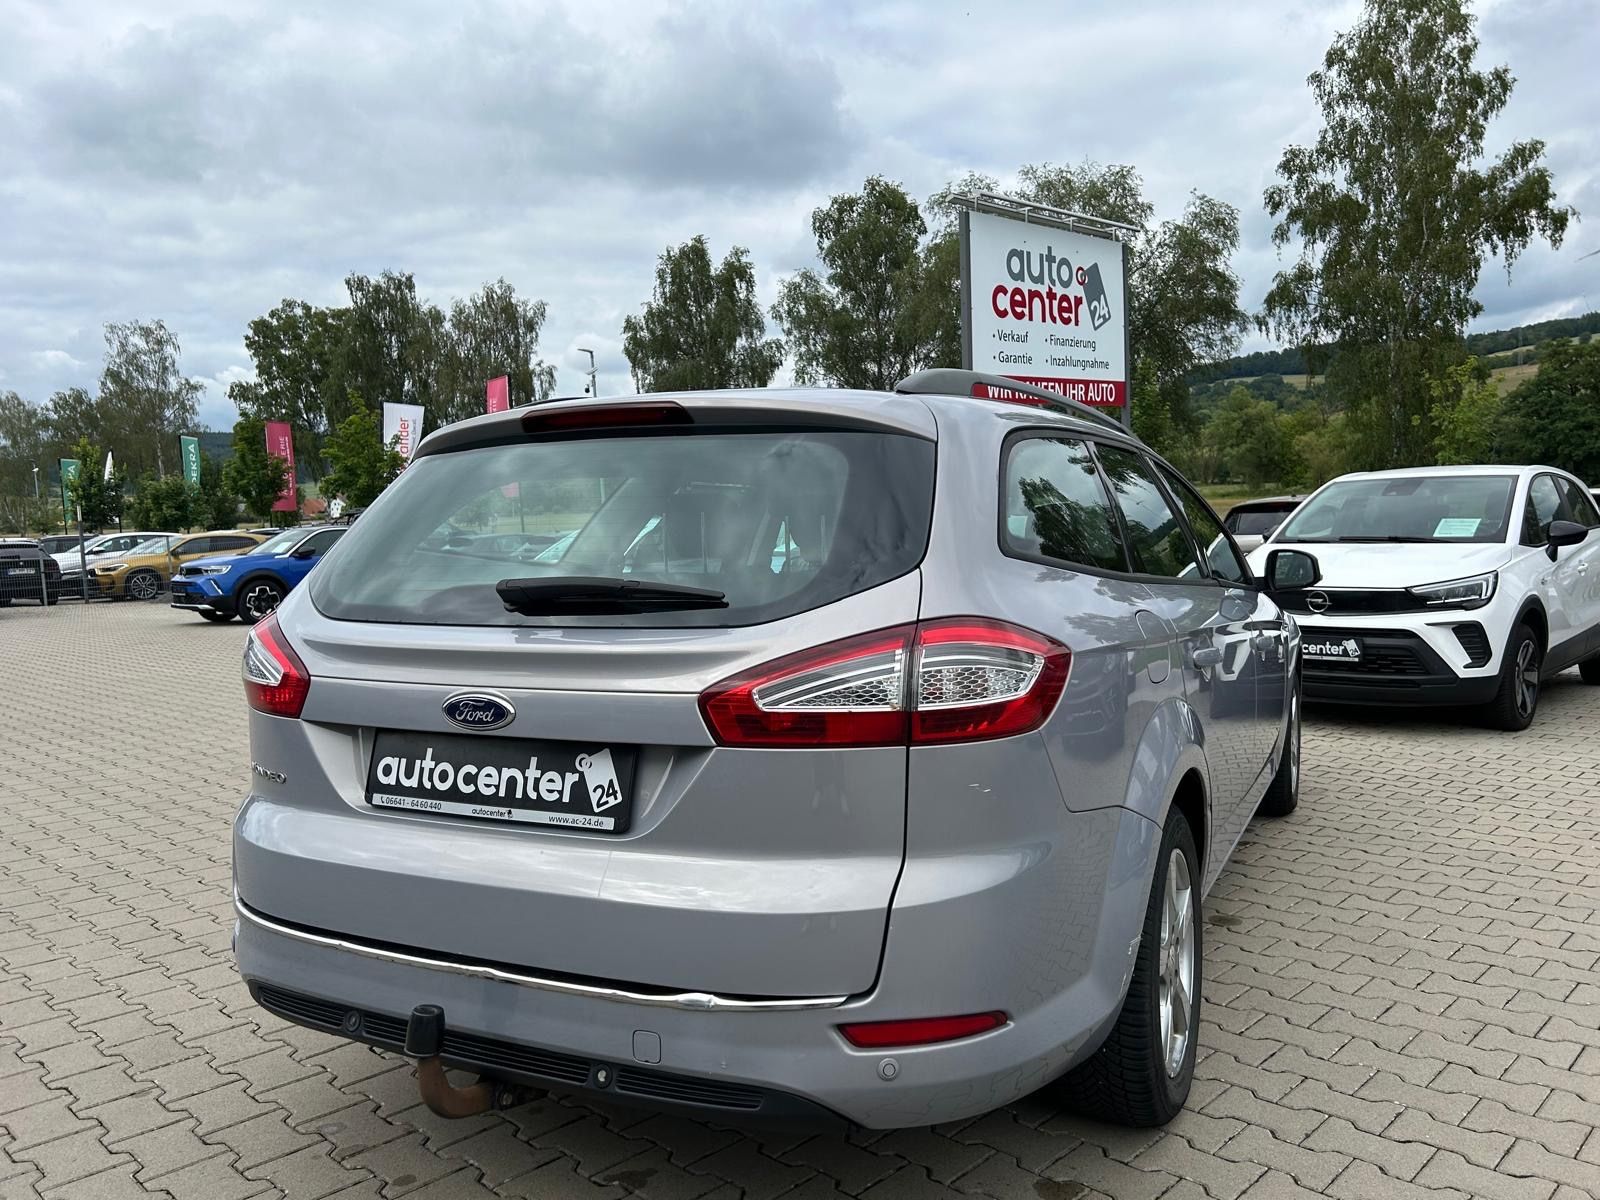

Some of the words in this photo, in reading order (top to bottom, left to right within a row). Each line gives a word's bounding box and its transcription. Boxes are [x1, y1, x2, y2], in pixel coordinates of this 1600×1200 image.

[1006, 245, 1073, 289] auto
[991, 284, 1083, 326] center
[1090, 296, 1109, 326] 24
[997, 329, 1028, 343] Verkauf
[1049, 334, 1096, 351] Finanzierung
[998, 351, 1033, 365] Garantie
[1050, 354, 1110, 371] Inzahlungnahme
[1066, 383, 1085, 400] IHR
[1087, 383, 1116, 402] AUTO
[1301, 641, 1345, 655] center
[456, 701, 494, 722] Ford
[592, 778, 619, 807] 24
[471, 807, 507, 818] autocenter
[548, 815, 604, 828] www.ac-24.de
